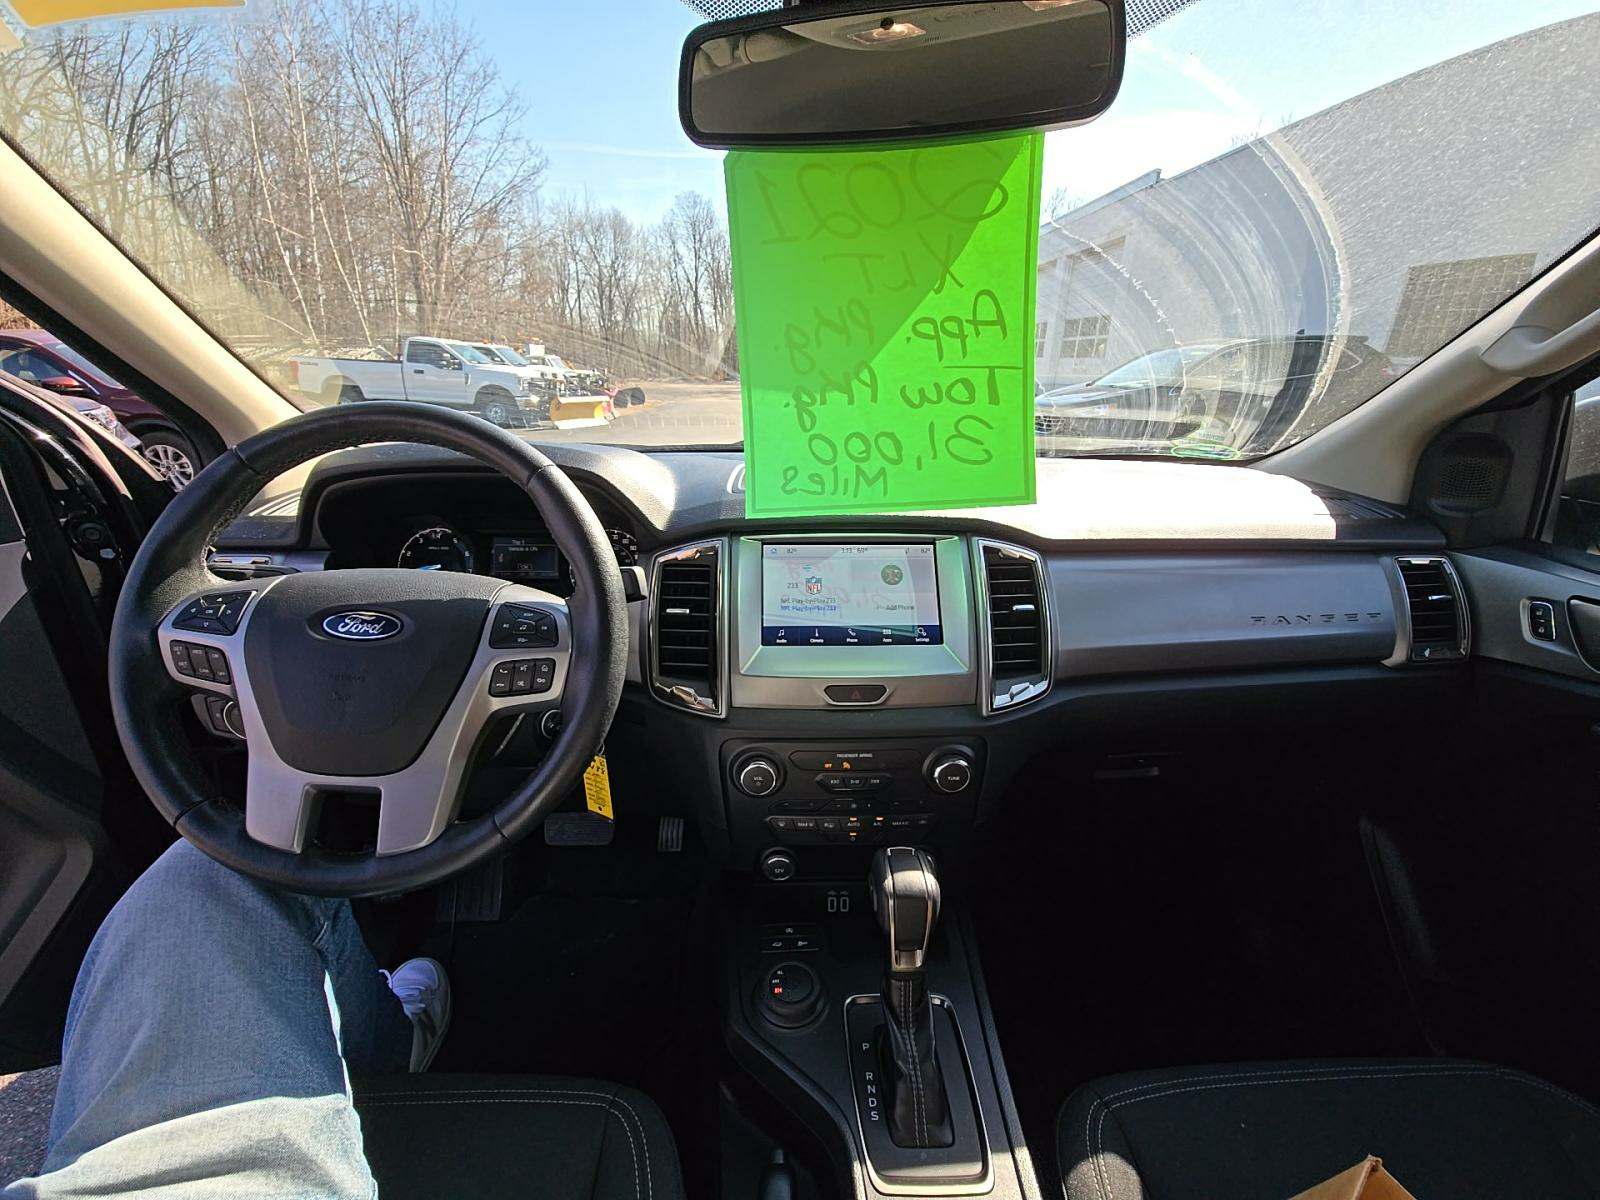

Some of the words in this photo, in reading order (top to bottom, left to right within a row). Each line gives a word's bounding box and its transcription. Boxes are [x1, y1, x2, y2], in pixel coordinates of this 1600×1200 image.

[807, 583, 822, 593] NFL
[337, 614, 384, 635] Ford
[866, 1072, 873, 1080] R
[868, 1085, 875, 1094] N
[869, 1098, 877, 1107] D
[871, 1111, 879, 1121] S
